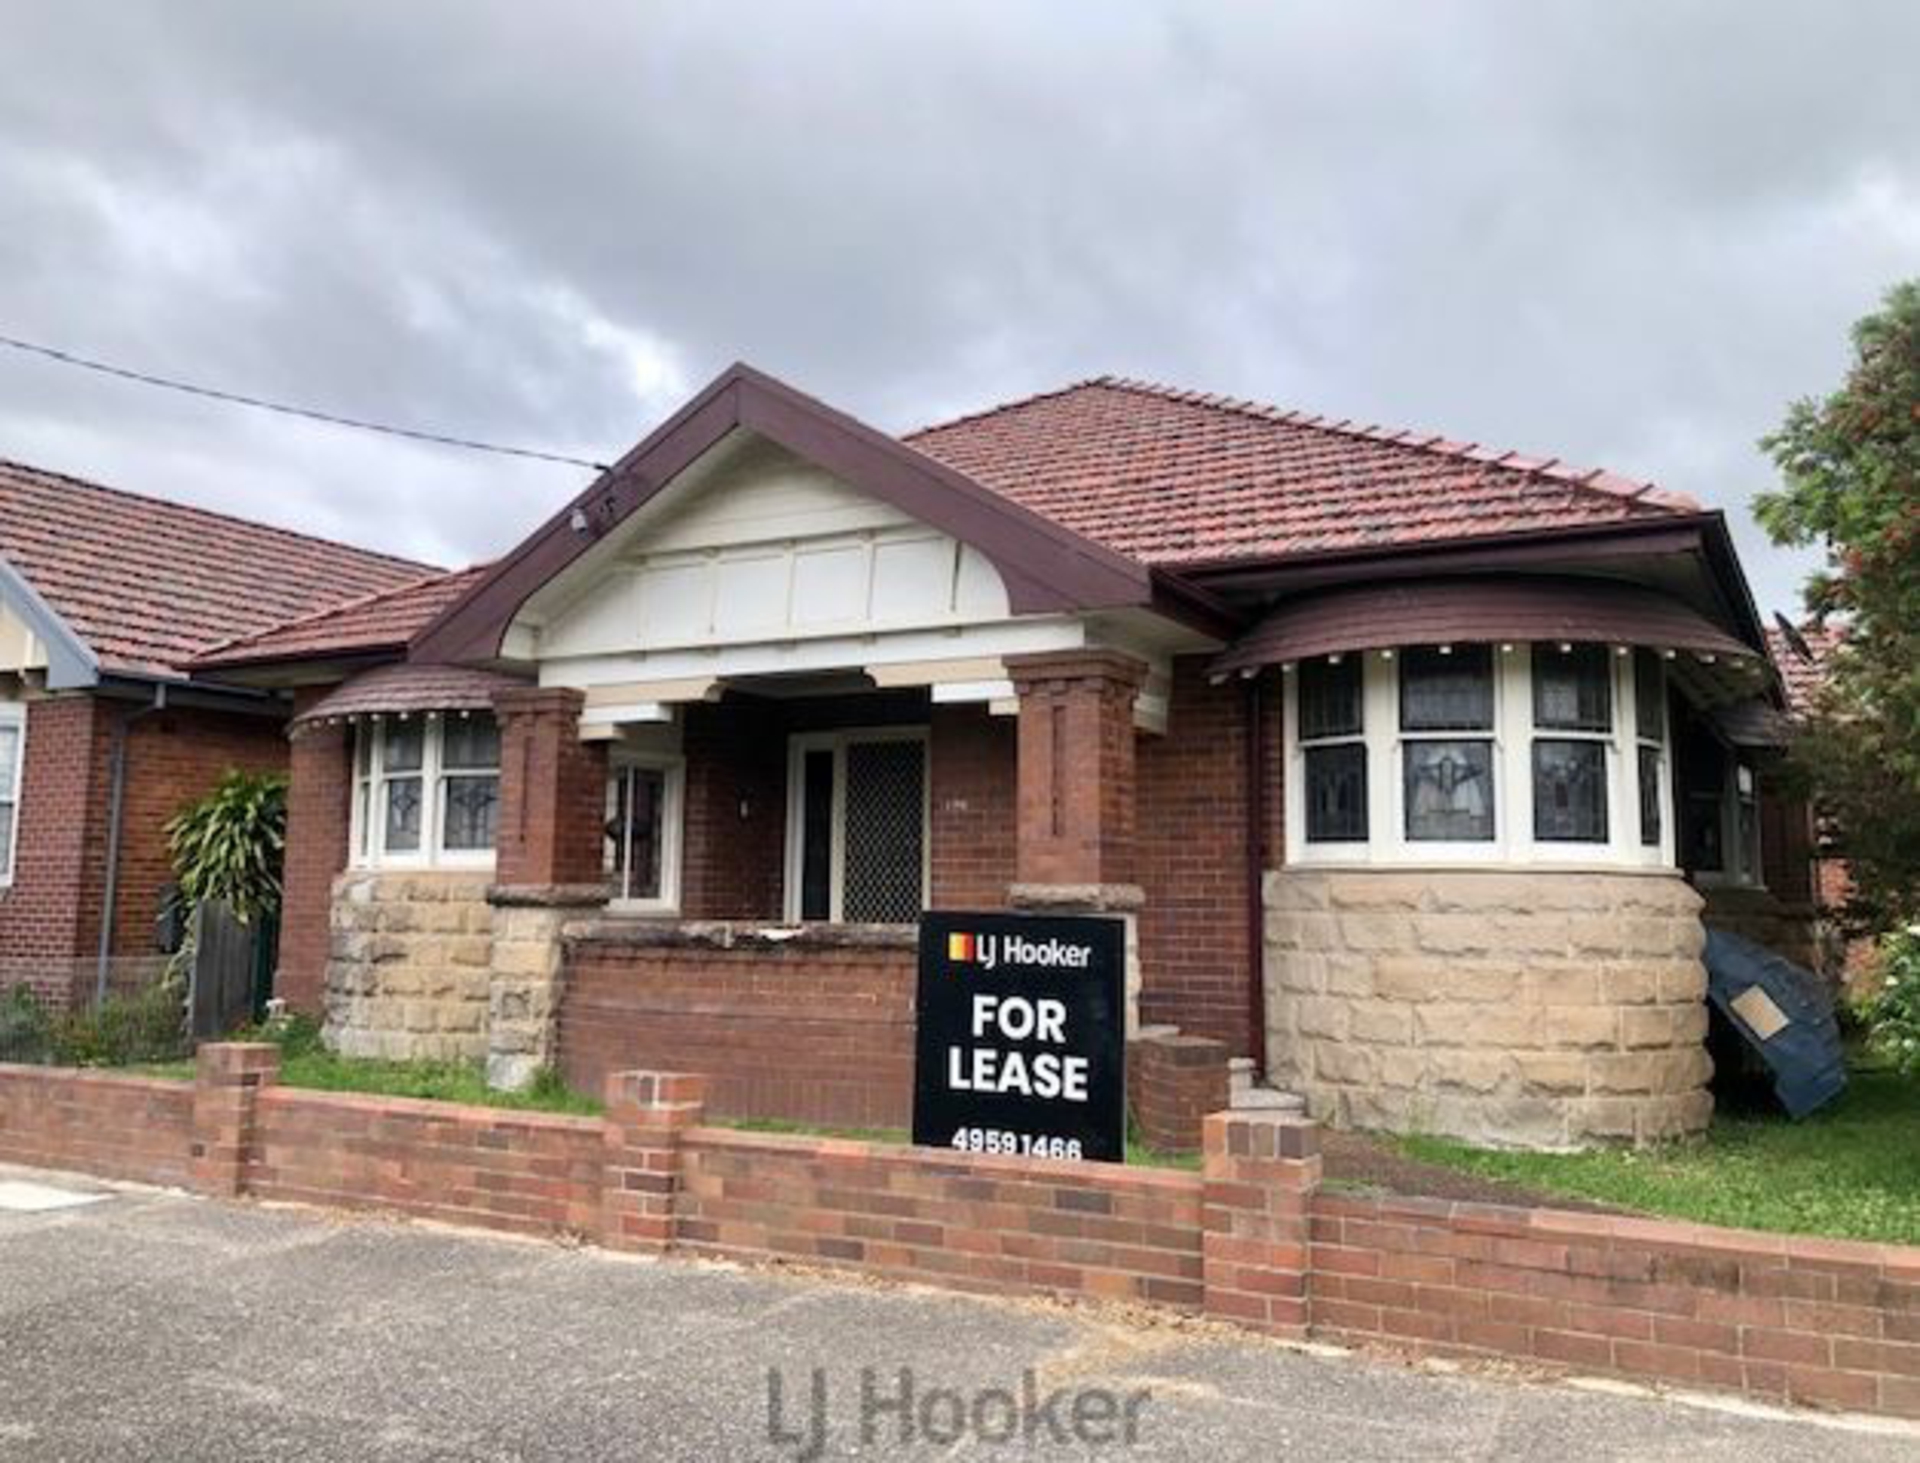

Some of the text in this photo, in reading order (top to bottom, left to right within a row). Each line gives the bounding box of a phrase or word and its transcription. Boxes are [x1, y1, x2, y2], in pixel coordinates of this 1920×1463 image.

[976, 935, 1091, 969] LJ Hooker
[972, 994, 1066, 1043] FOR
[949, 1047, 1088, 1101] LEASE
